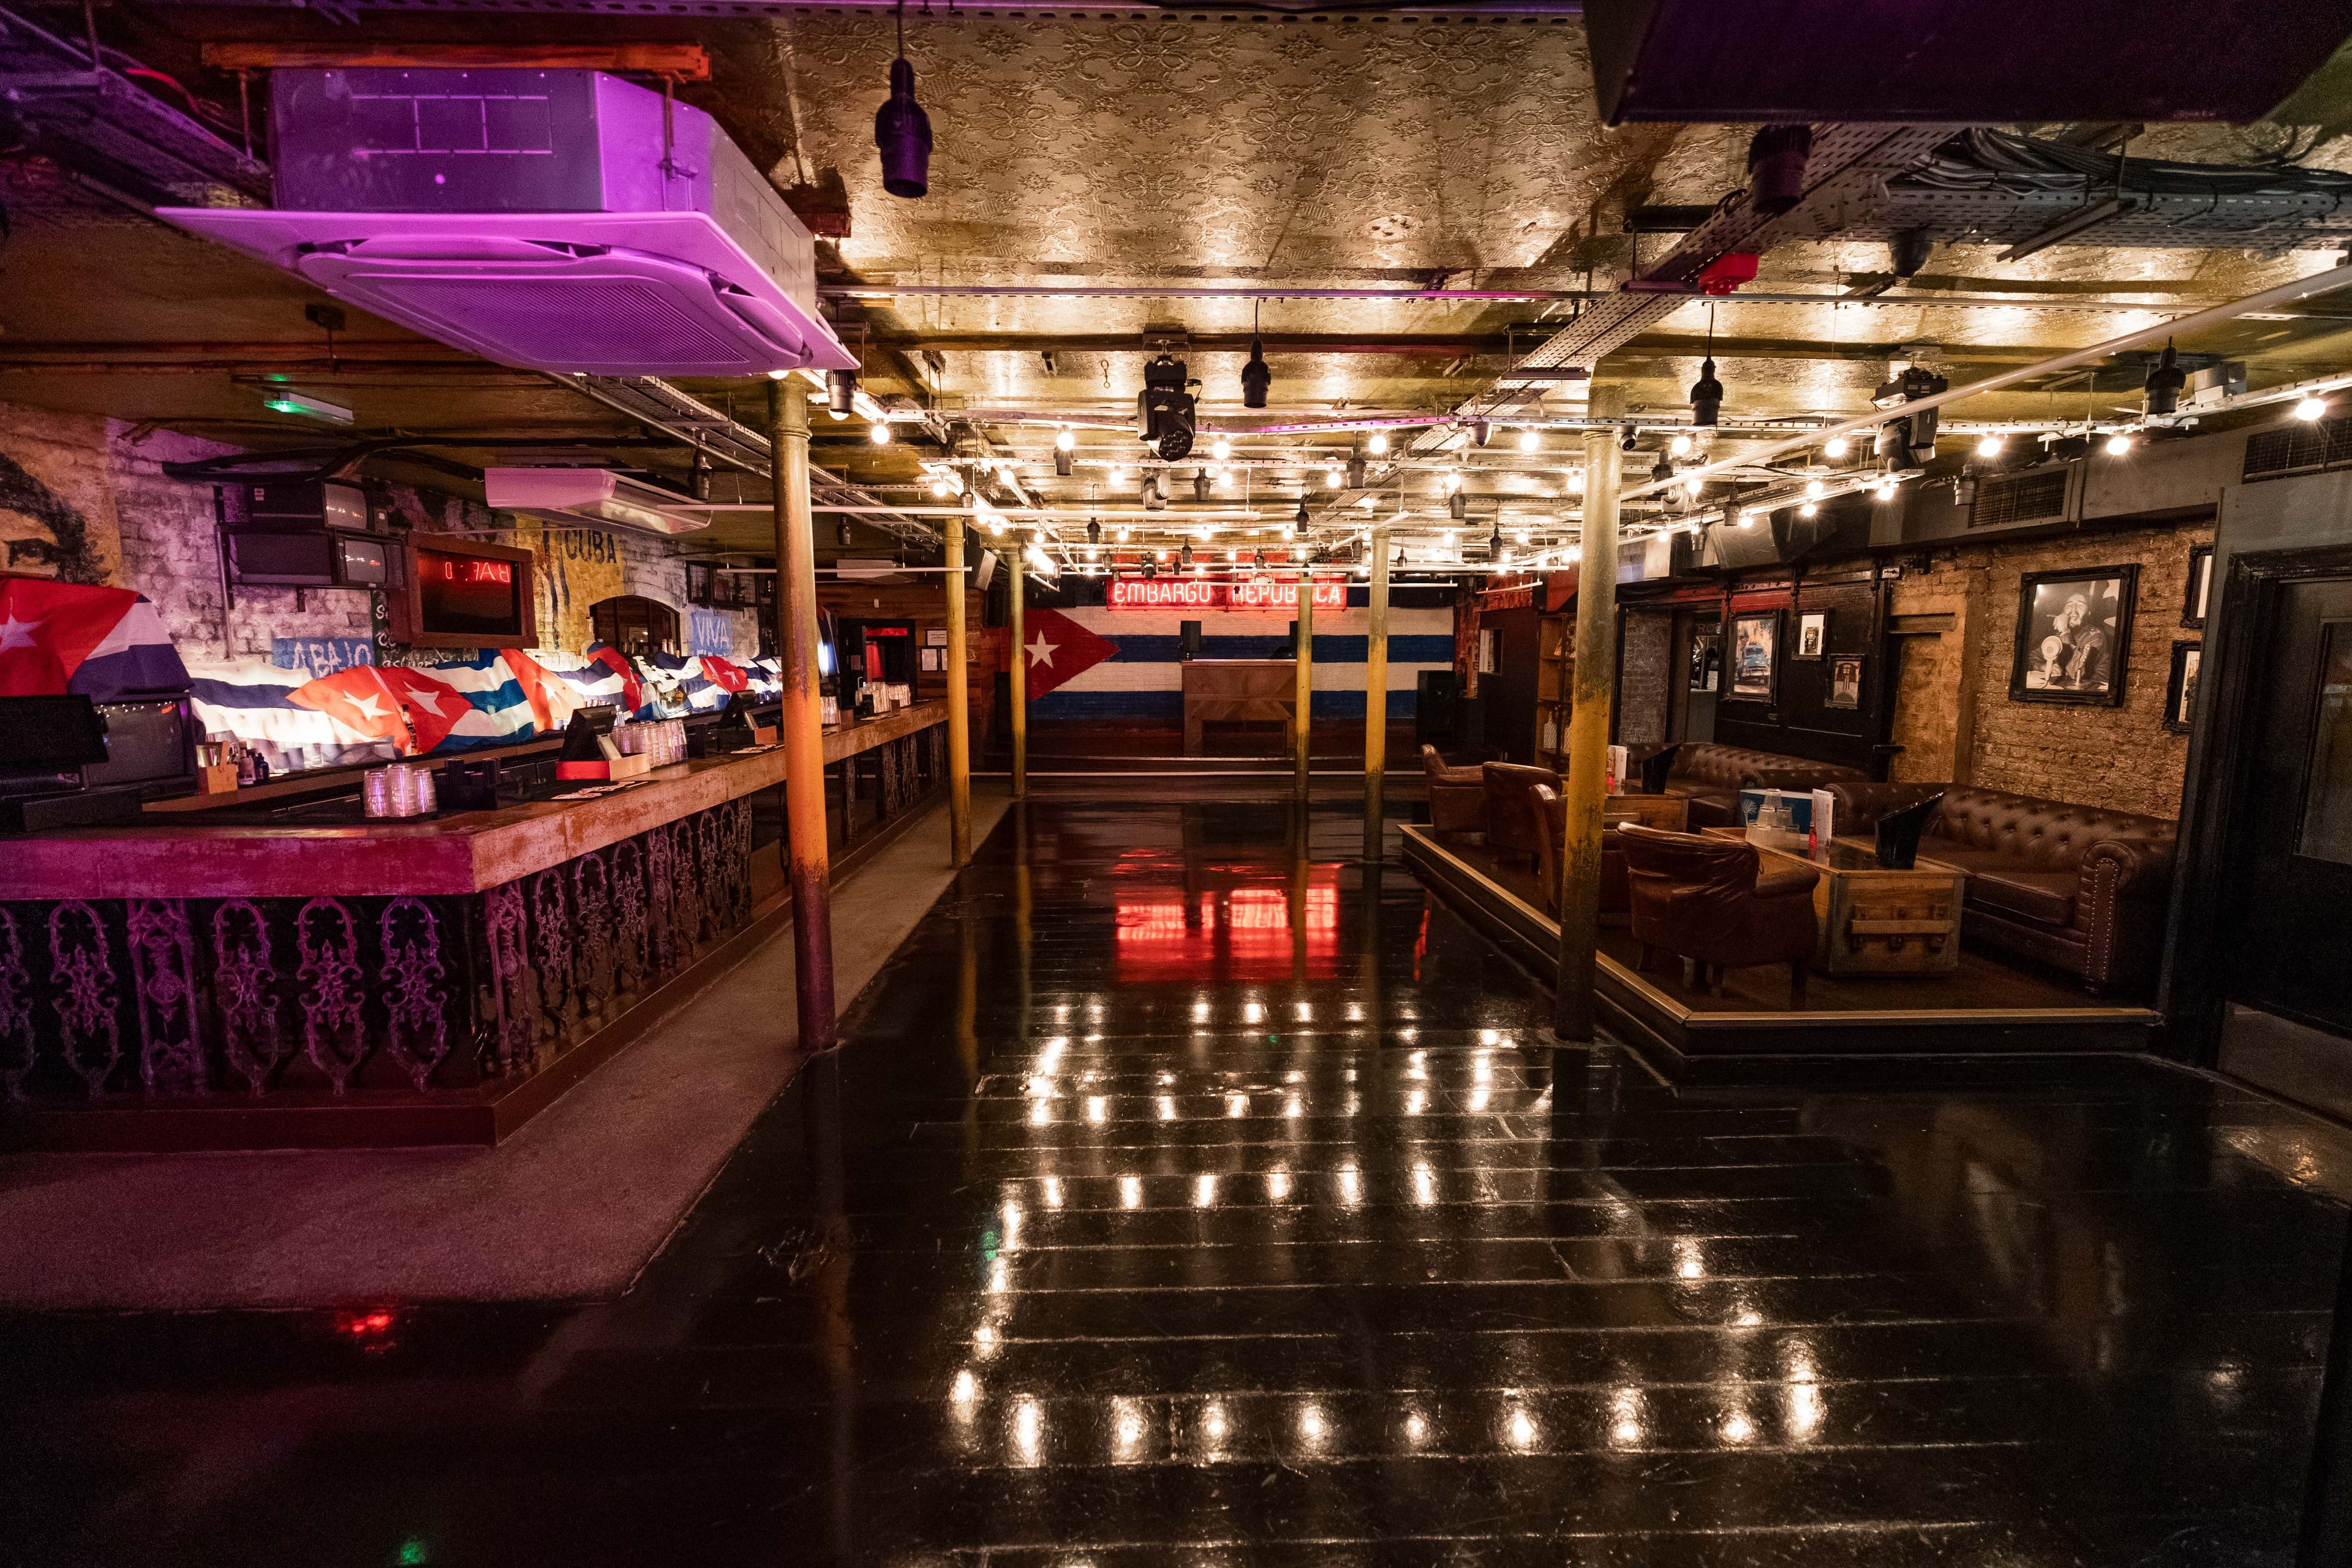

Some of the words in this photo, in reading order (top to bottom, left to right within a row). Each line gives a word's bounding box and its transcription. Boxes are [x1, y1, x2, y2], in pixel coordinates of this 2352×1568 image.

[564, 529, 617, 564] CUBA
[1114, 582, 1212, 603] EMBARGO
[1232, 584, 1341, 604] REPUBCA
[696, 616, 729, 648] VIVA
